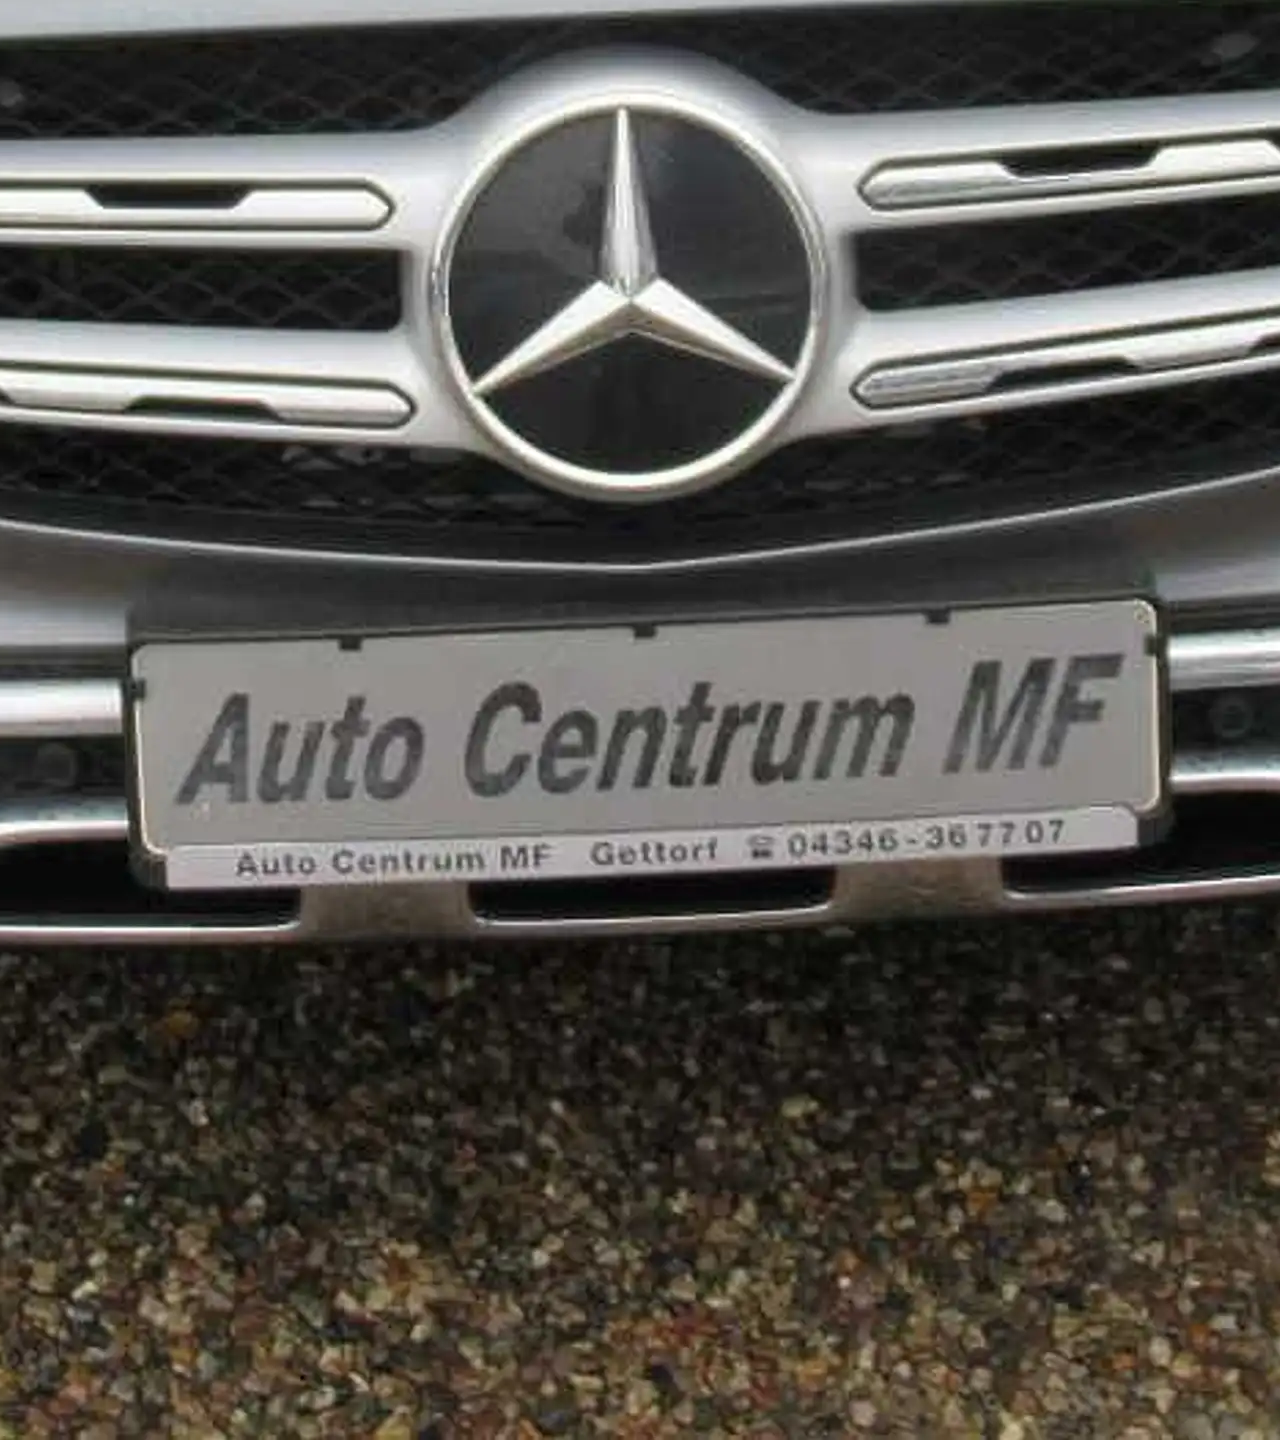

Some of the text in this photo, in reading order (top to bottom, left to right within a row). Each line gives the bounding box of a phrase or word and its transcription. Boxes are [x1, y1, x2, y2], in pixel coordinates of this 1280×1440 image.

[174, 653, 1125, 806] Auto Centrum MF
[235, 850, 318, 879] Auto
[331, 846, 487, 875] Centrum
[500, 842, 554, 871] MF
[589, 838, 719, 867] Gettorf
